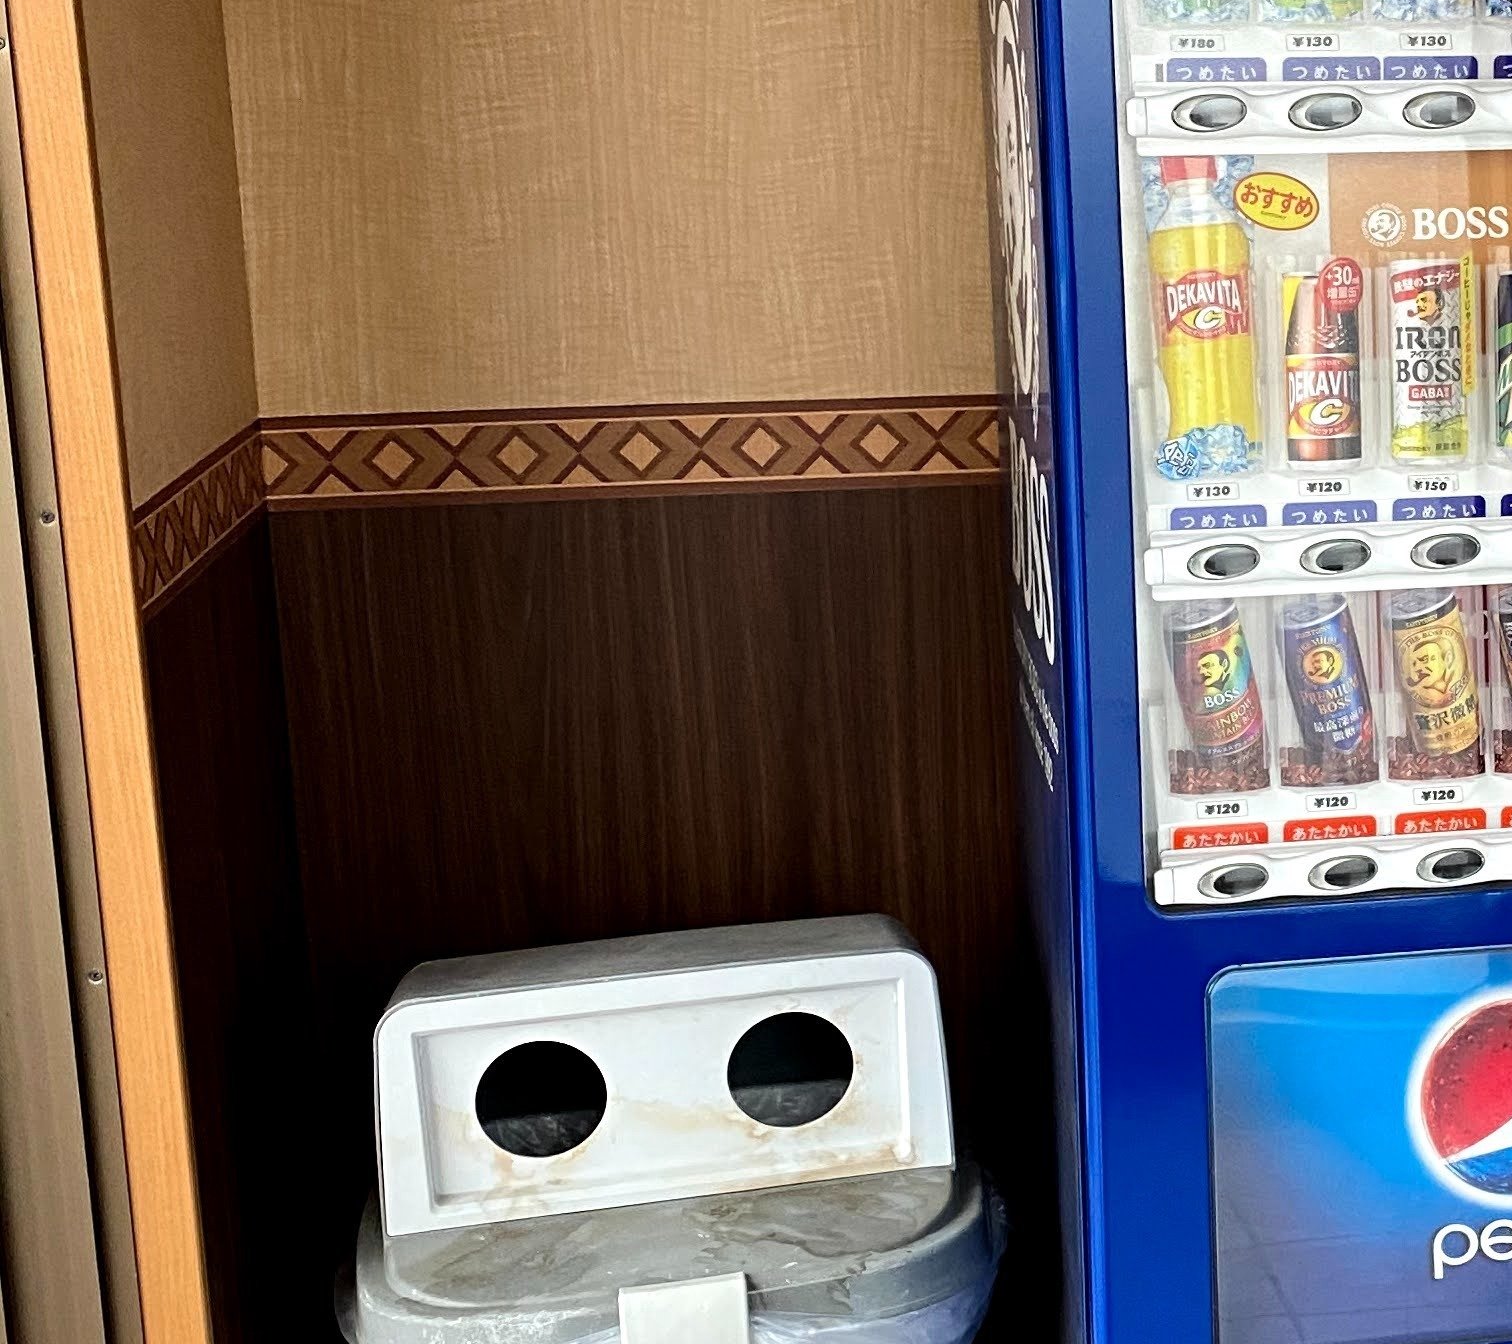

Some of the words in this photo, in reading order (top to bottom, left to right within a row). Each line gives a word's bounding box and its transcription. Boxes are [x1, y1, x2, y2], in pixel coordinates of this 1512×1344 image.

[1294, 37, 1333, 48] ¥130
[1409, 35, 1447, 48] ¥130
[1174, 64, 1257, 81] つめたい
[1292, 63, 1371, 80] つめたい
[1390, 62, 1469, 79] つめたい
[1240, 182, 1313, 218] おすすめ
[1412, 207, 1510, 241] BOSS
[1166, 279, 1242, 322] DEKAVITA
[1194, 306, 1222, 329] C
[1396, 326, 1461, 349] IRON
[1396, 359, 1461, 383] BOSS
[1309, 399, 1343, 426] C
[1193, 485, 1231, 498] ¥130
[1307, 481, 1342, 493] ¥120
[1413, 480, 1448, 492] ¥150
[1291, 507, 1370, 524] つめたい
[1401, 502, 1478, 519] つめたい
[1179, 512, 1259, 529] つめたい
[1008, 416, 1055, 667] BOSS
[1204, 688, 1241, 708] BOSS
[1317, 697, 1352, 715] BOSS
[1314, 796, 1349, 807] ¥120
[1421, 790, 1455, 801] ¥120
[1204, 803, 1241, 815] ¥120
[1291, 824, 1368, 840] あたたかい
[1403, 817, 1478, 832] あたたかい
[1182, 832, 1259, 848] あたたかい
